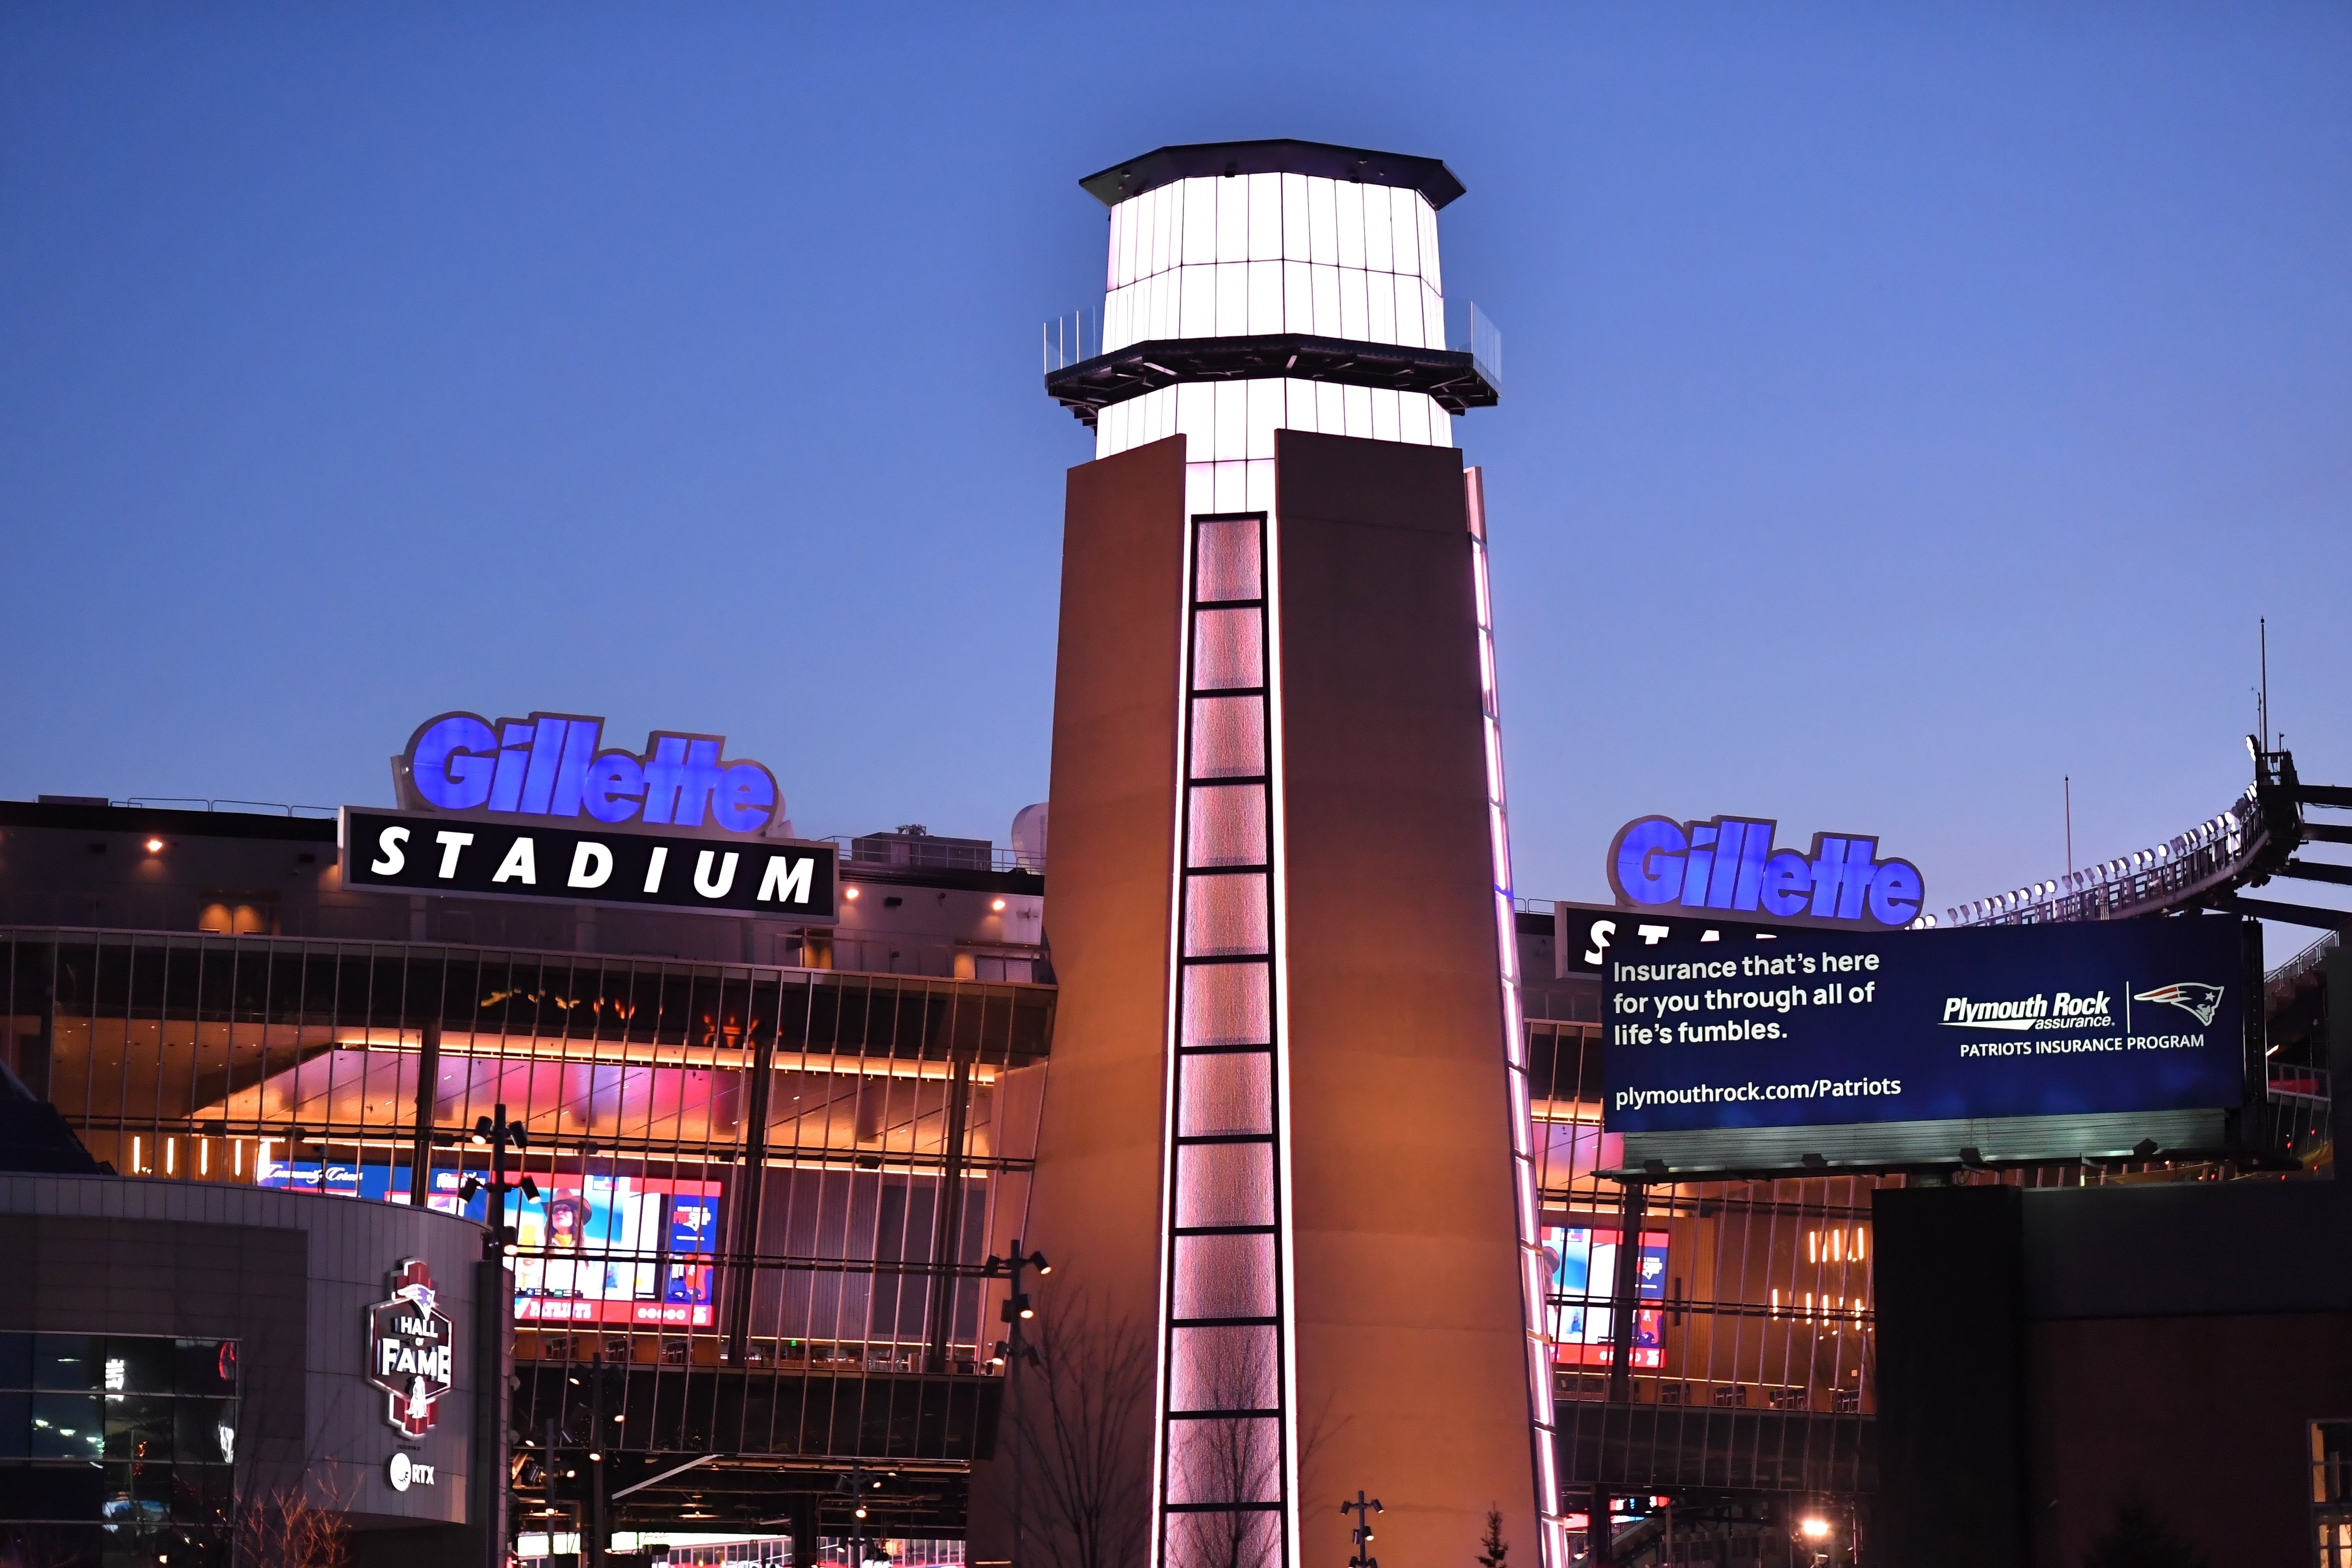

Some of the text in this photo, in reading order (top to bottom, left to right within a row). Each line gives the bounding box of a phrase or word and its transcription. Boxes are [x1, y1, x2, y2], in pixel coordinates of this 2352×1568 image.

[413, 717, 774, 832] Gillette
[371, 826, 814, 903] STADIUM
[1618, 820, 1920, 925] Gillette
[1615, 952, 1879, 982] Insurance that’s here
[1614, 981, 1875, 1018] for you through all of
[1943, 991, 2111, 1022] Plymouth Rock
[1615, 1020, 1787, 1045] life’s fumbles.
[1961, 1034, 2204, 1057] PATRIOTS INSURANCE PROGRAM
[1616, 1077, 1901, 1110] plymouthrock.com/Patriots
[401, 1316, 438, 1338] HALL
[415, 1337, 424, 1346] OF
[382, 1338, 451, 1383] FAME
[412, 1464, 434, 1485] RTX
